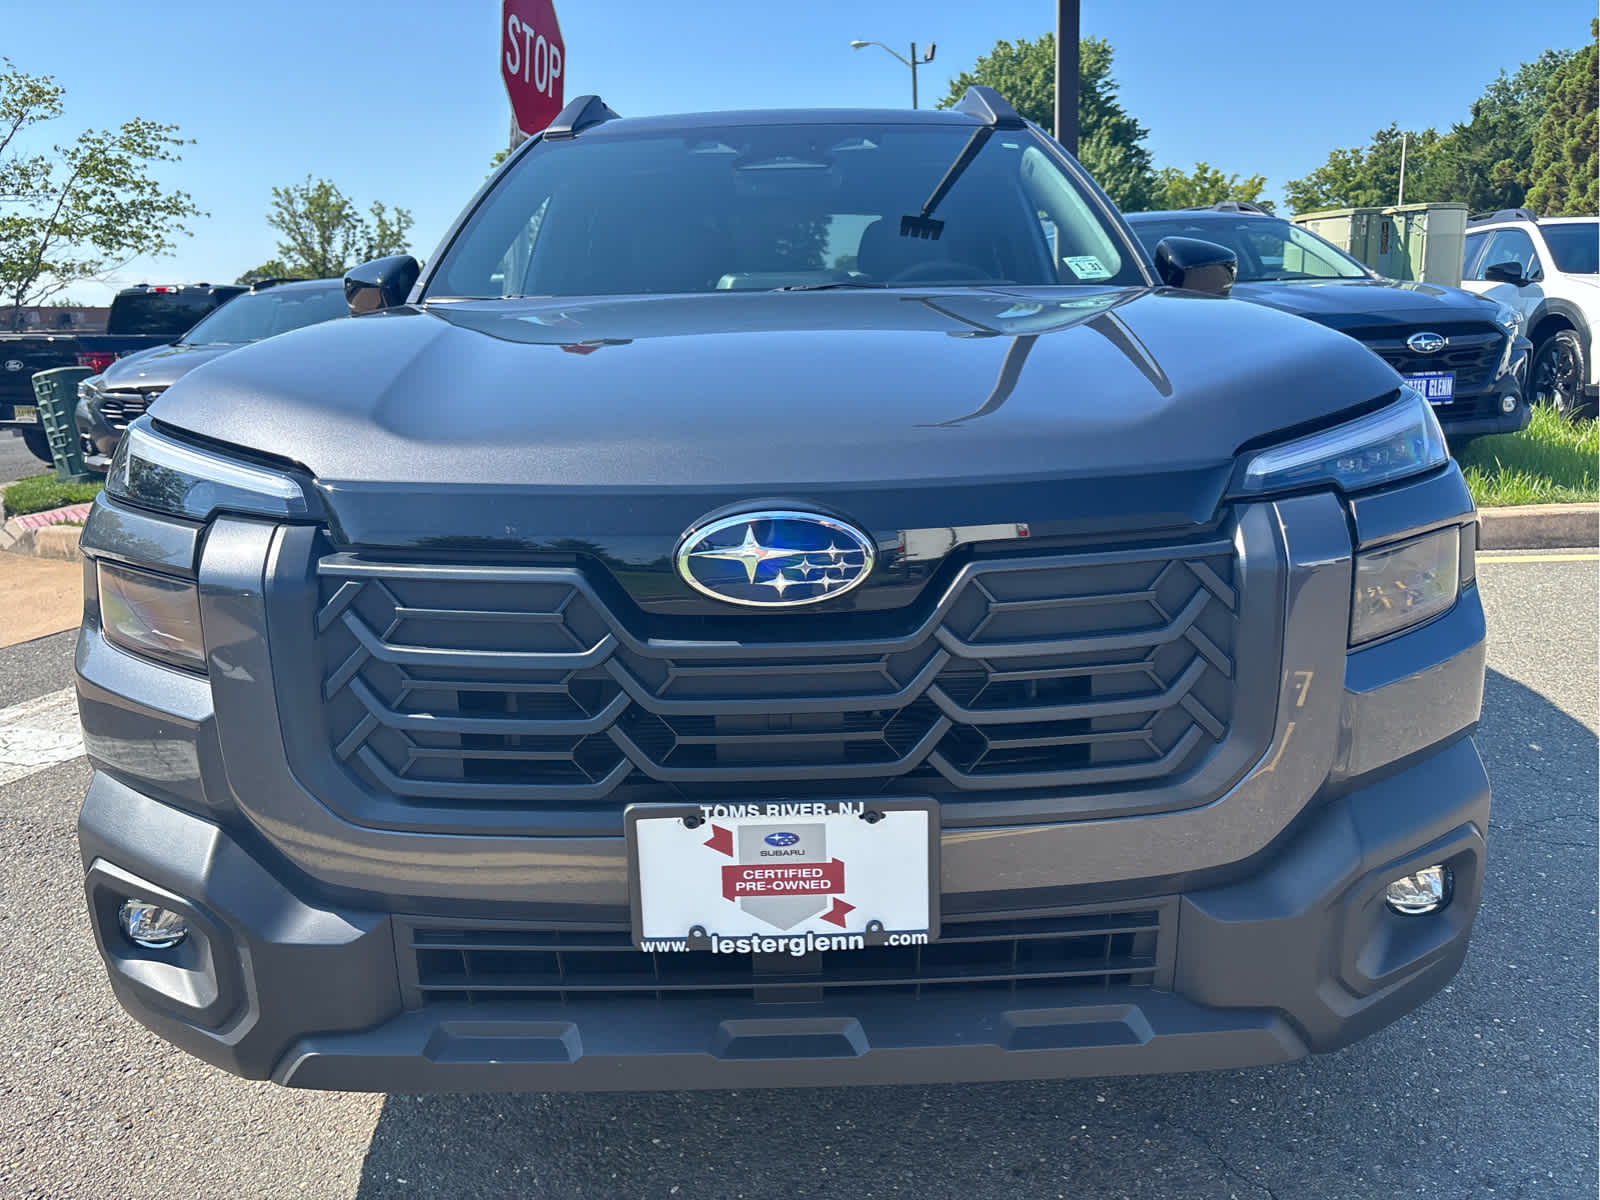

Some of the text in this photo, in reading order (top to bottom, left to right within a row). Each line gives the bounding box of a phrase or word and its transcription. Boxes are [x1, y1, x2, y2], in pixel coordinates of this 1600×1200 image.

[506, 14, 561, 98] STOP
[1428, 378, 1452, 396] GLENN
[700, 804, 760, 817] TOMS
[839, 801, 865, 815] NJ
[743, 868, 823, 880] CERTIFIED
[736, 879, 831, 892] PRE-OWNED
[640, 931, 929, 957] www. lesterglenn .com
